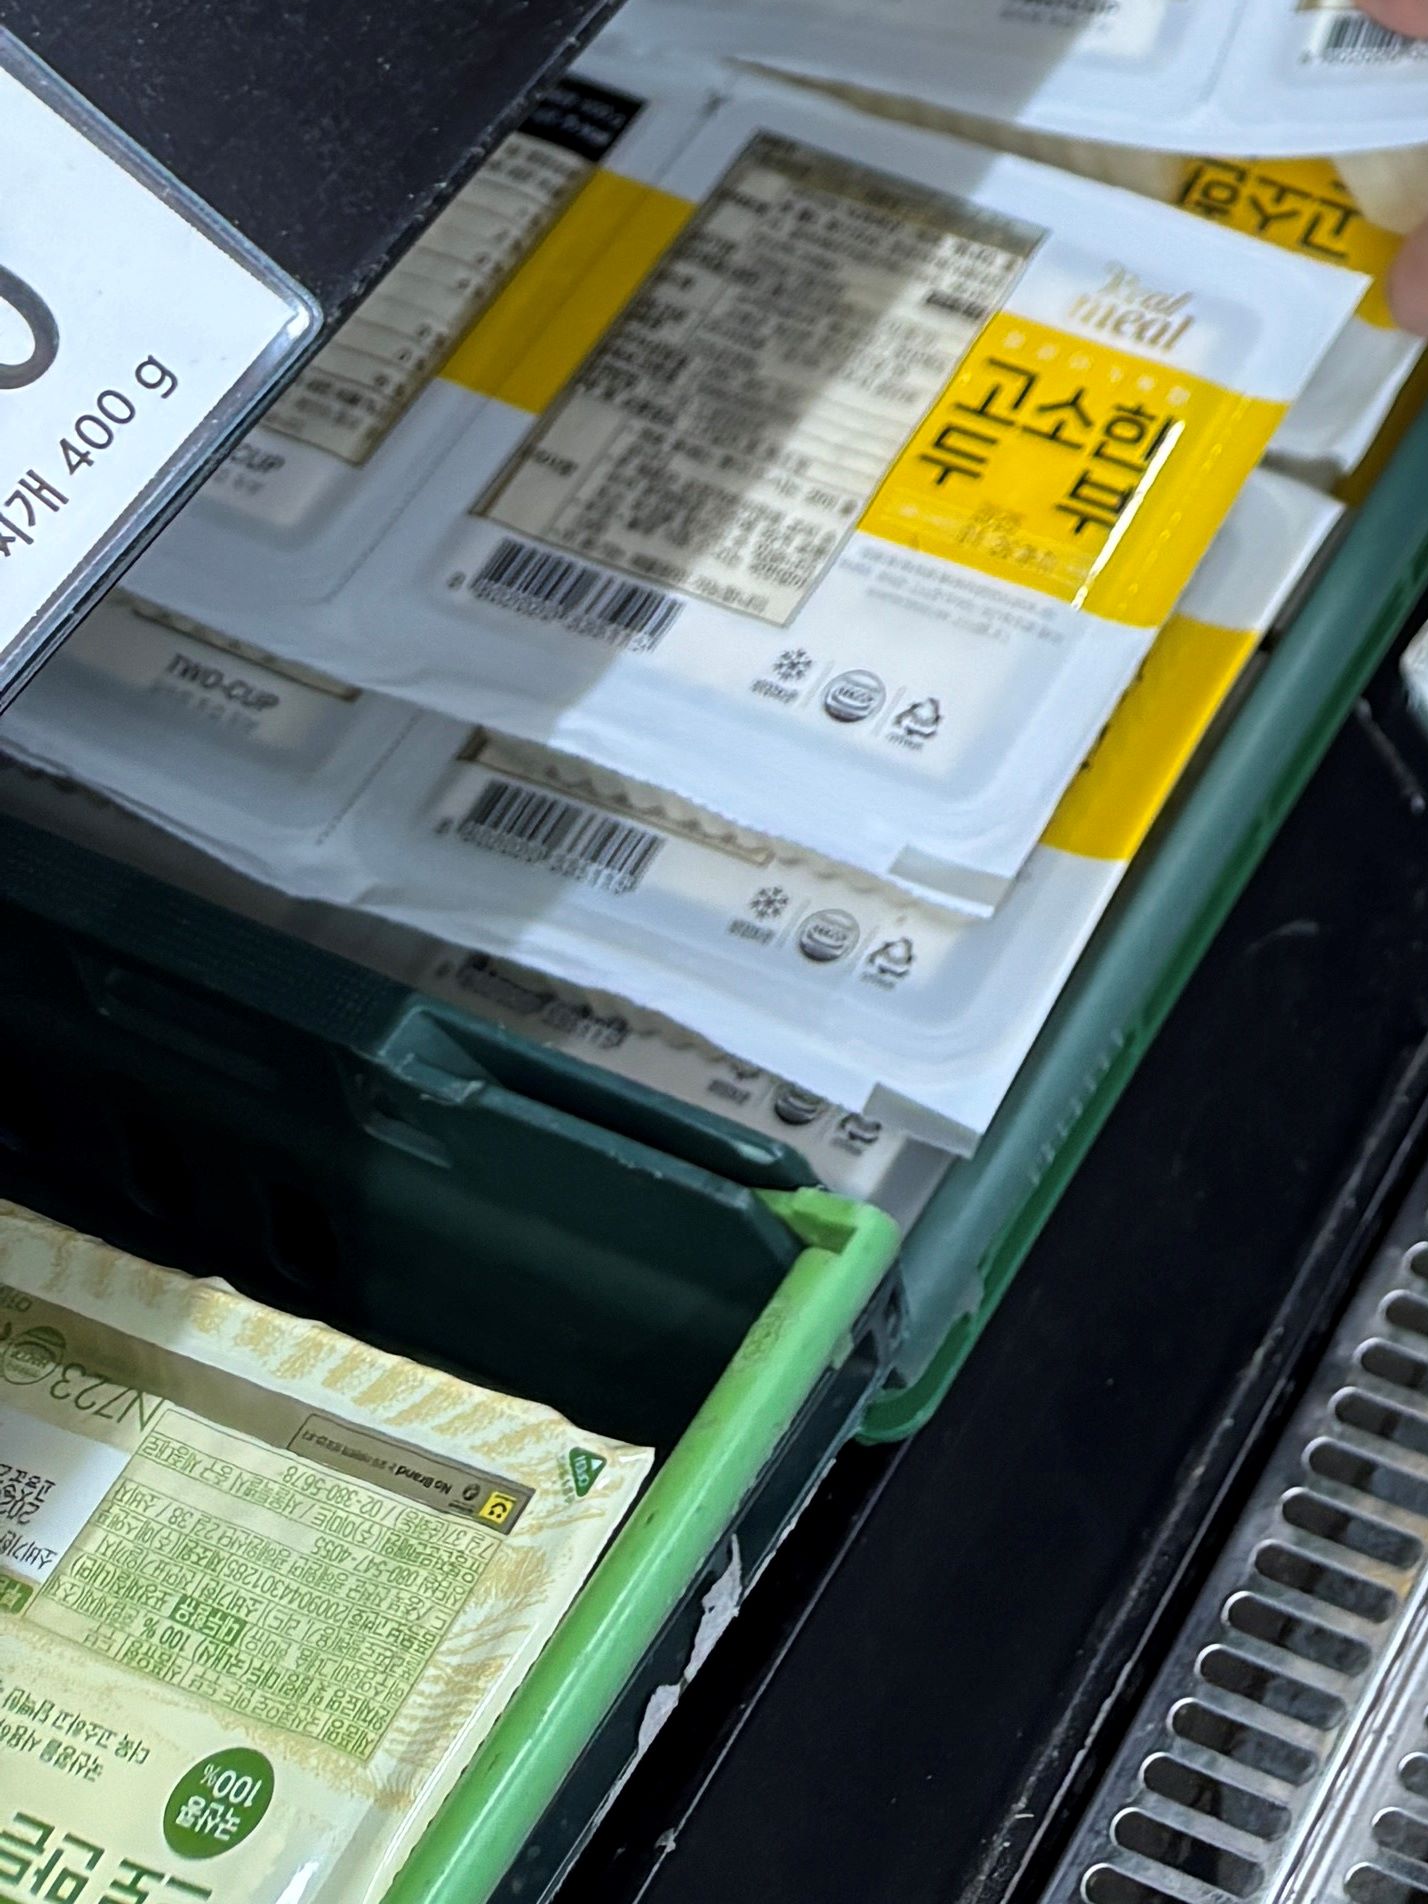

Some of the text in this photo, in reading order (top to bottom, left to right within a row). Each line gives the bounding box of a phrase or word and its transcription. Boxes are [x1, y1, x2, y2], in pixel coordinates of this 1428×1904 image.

[59, 389, 136, 476] 400
[135, 353, 179, 400] g
[952, 356, 1176, 475] 고소한
[109, 1479, 162, 1515] 소비자
[197, 1459, 235, 1489] 중구
[226, 1469, 308, 1518] 서울특별시
[279, 1464, 385, 1518] 02-380-5678
[166, 1506, 194, 1530] 38
[309, 1502, 386, 1549] (주)이마트
[306, 1532, 468, 1607] 상담실 080-547-4055
[461, 1534, 494, 1560] 7길
[196, 1578, 263, 1619] 소비기한
[219, 1558, 351, 1624] 2009044301285
[80, 1620, 121, 1654] 두부
[157, 1625, 193, 1652] 100
[166, 1595, 247, 1645] 대두함유
[343, 1605, 437, 1657] 품목보고번호
[117, 1638, 188, 1683] 식품유형
[189, 1637, 284, 1690] 대두(국내산)
[320, 1717, 377, 1756] 제품명
[193, 1759, 266, 1810] 100%
[172, 1791, 246, 1844] 국산콩
